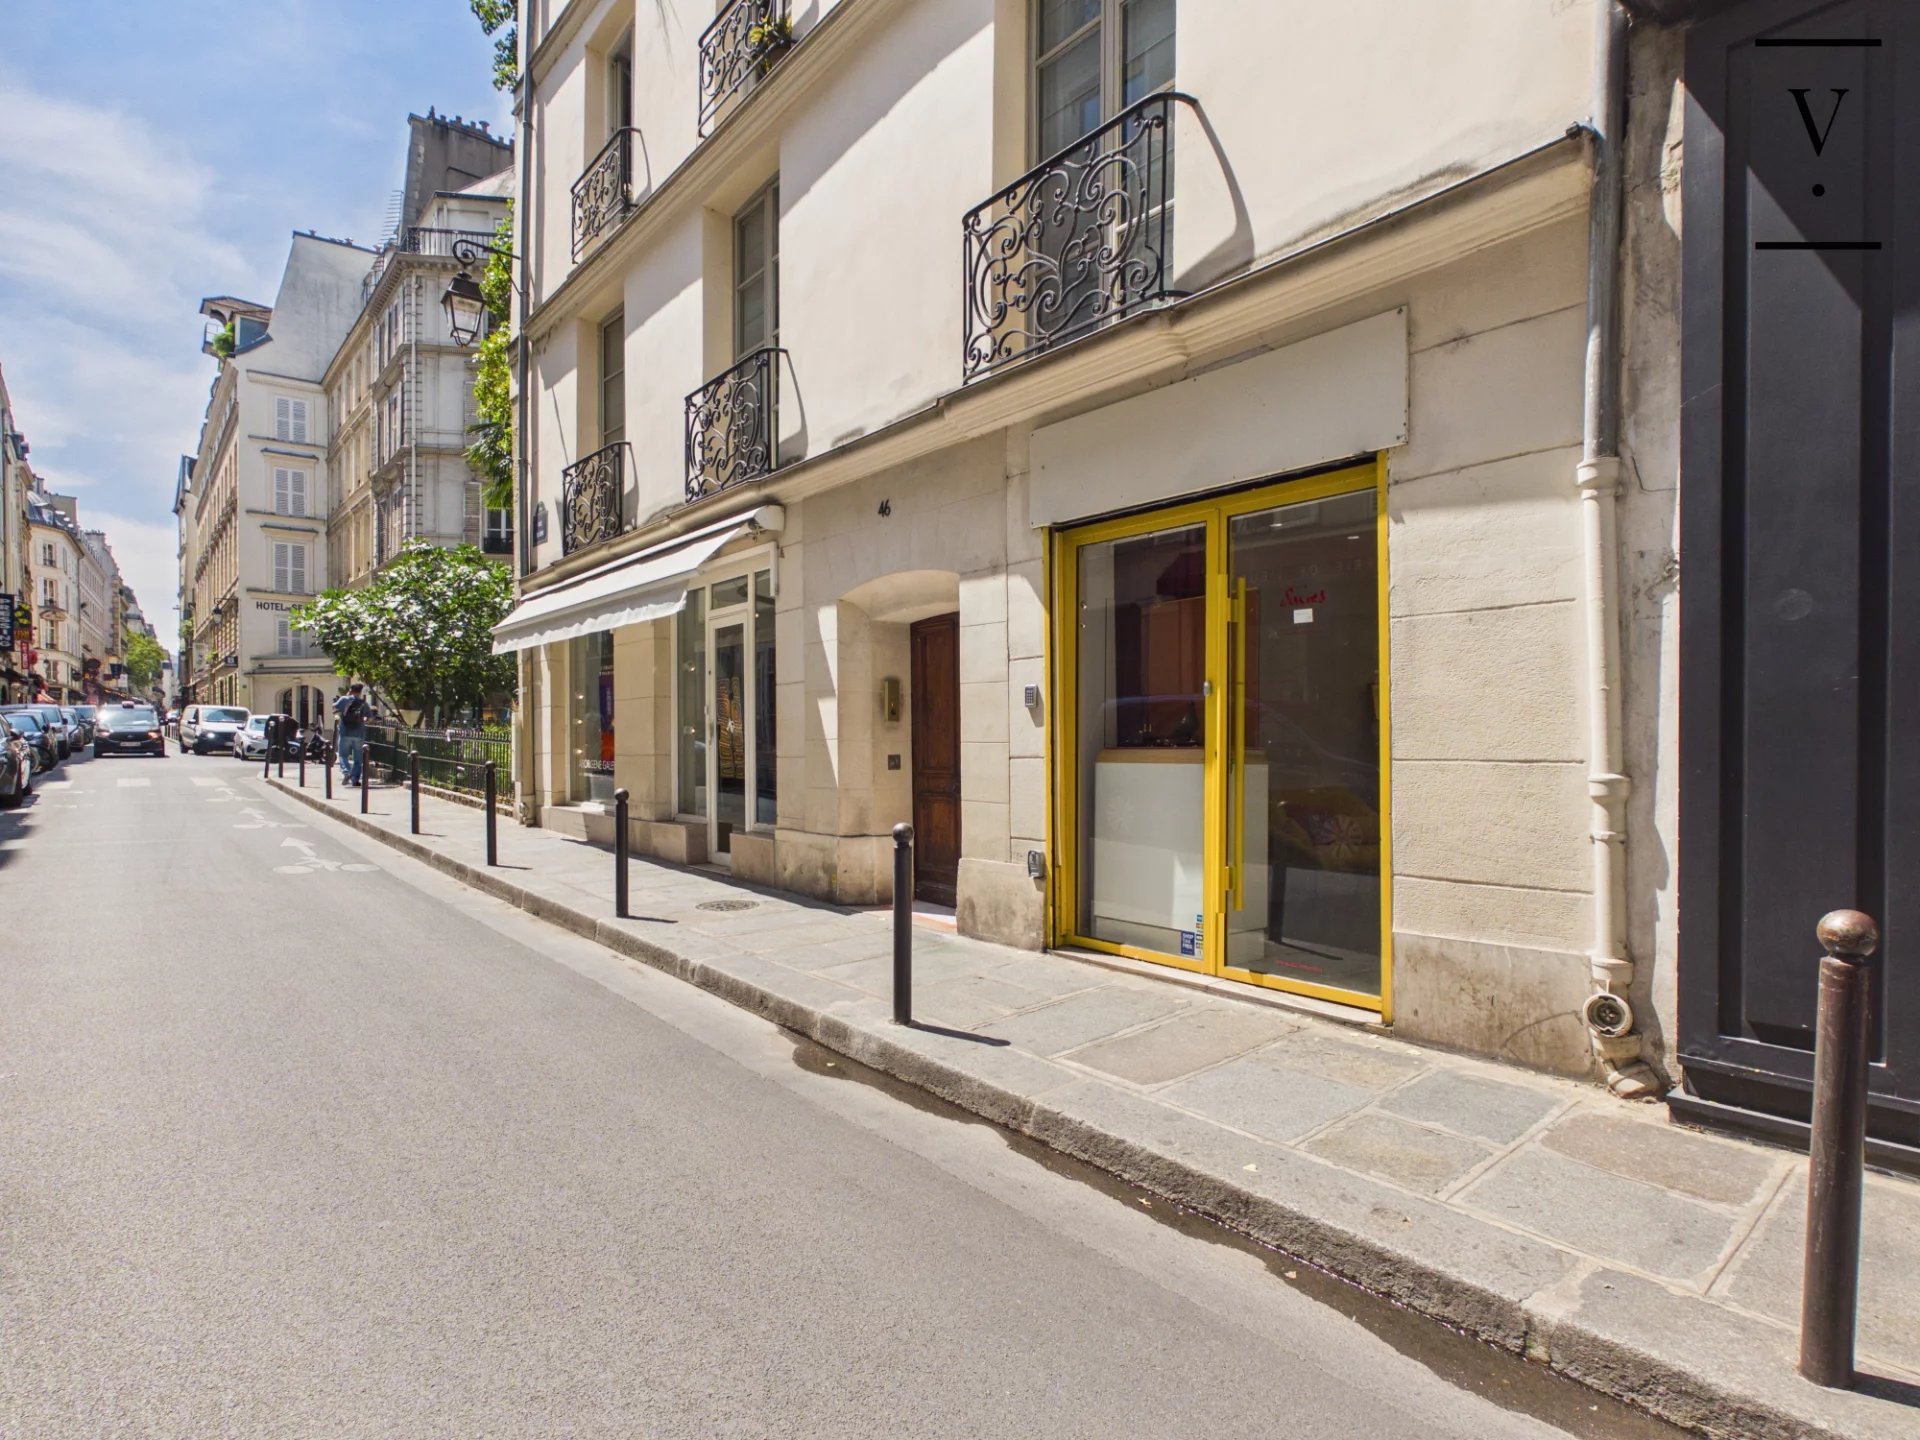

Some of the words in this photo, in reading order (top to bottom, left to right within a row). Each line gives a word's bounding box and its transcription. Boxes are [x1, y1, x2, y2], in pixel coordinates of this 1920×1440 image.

[878, 499, 891, 518] 46
[256, 601, 286, 611] HOTEL
[0, 598, 11, 647] PRESSING
